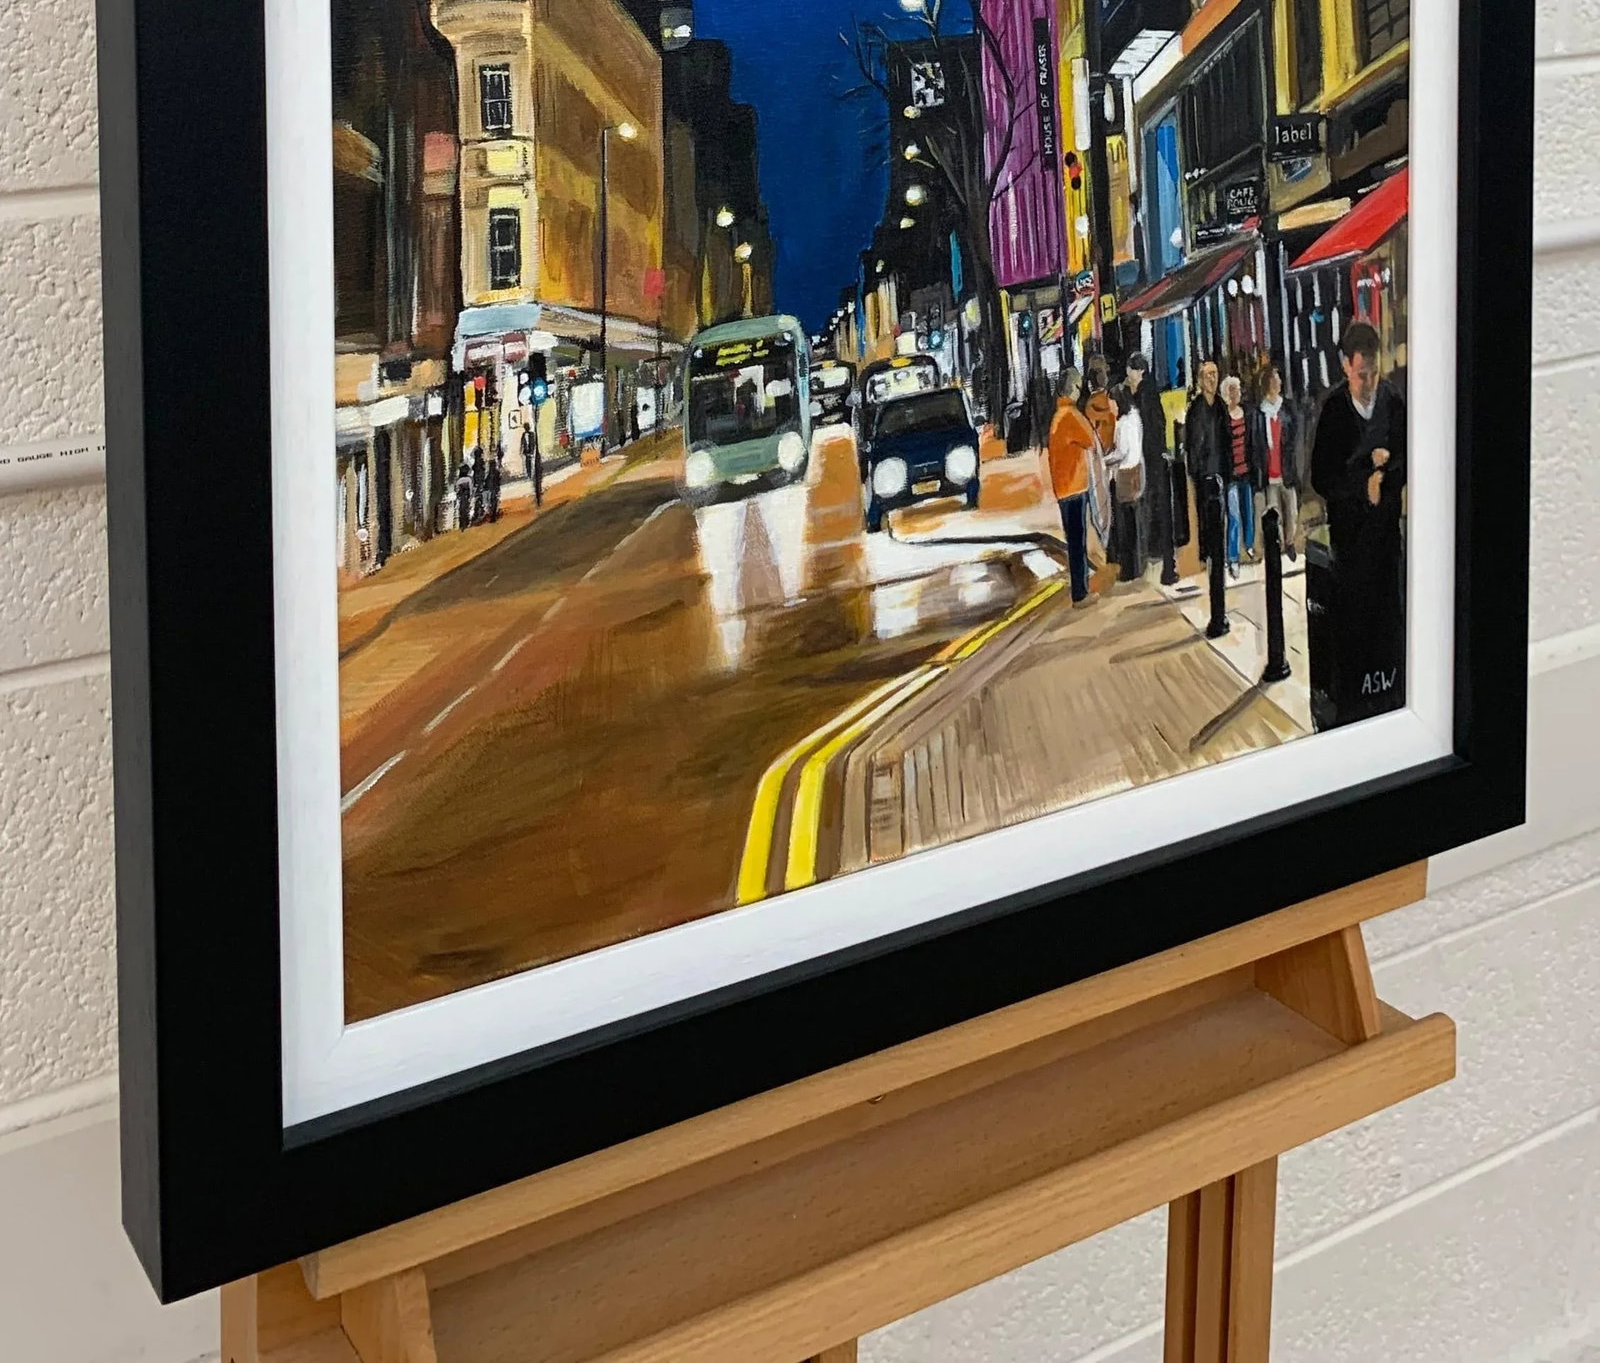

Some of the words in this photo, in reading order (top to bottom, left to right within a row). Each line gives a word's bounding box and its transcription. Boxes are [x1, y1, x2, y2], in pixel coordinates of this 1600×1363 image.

[1038, 44, 1048, 86] FRASER
[1041, 92, 1050, 108] OF
[1043, 115, 1053, 155] HOUSE
[1274, 121, 1312, 145] label
[1229, 186, 1255, 199] CAFE
[1226, 195, 1259, 211] ROUGE
[17, 452, 53, 463] GAUGE
[59, 447, 89, 457] HIGH
[1361, 667, 1397, 695] ASW
